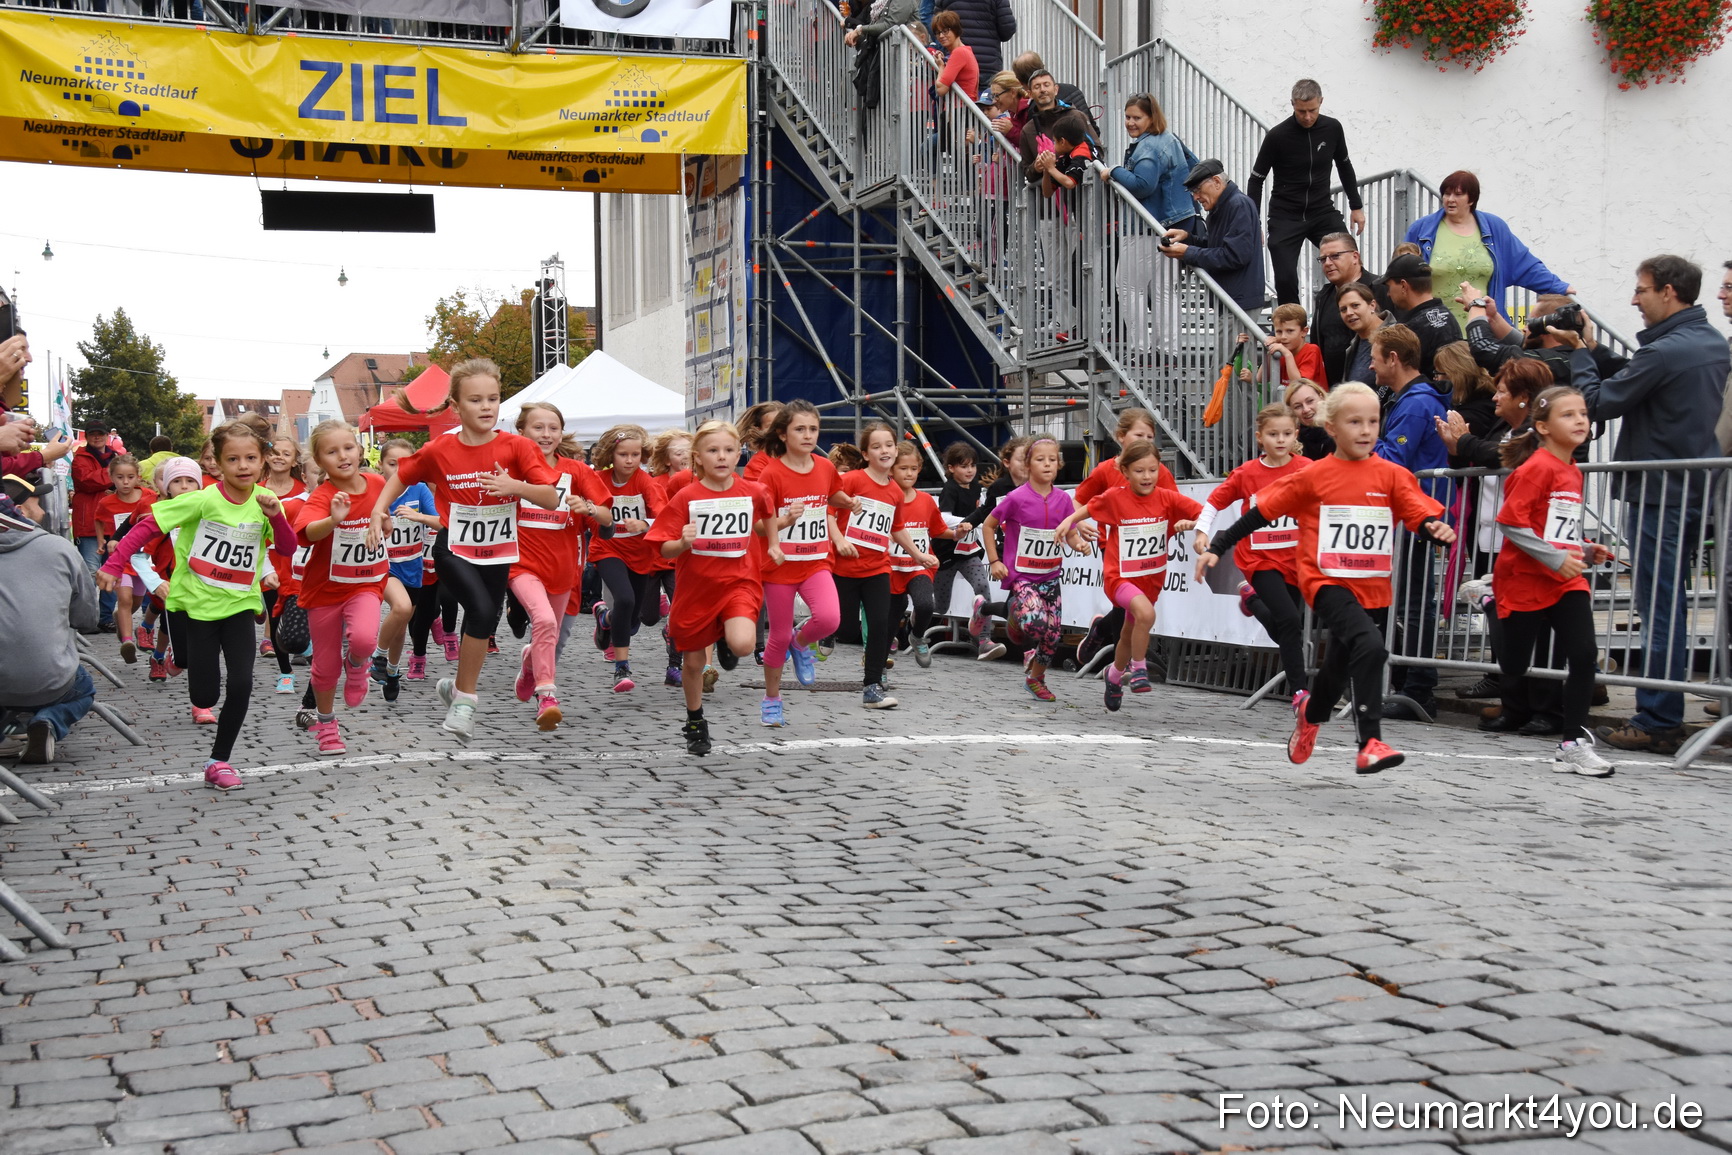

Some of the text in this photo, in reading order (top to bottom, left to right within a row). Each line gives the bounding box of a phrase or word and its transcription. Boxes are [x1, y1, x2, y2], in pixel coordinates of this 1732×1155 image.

[20, 69, 198, 100] Neumarkter Stadtlauf
[298, 59, 467, 126] ZIEL
[559, 108, 710, 123] Neumarkter Stadtlauf
[23, 120, 185, 143] Neumarkter Stadtlauf
[507, 150, 645, 166] Neumarkter Stadtlauf
[449, 481, 482, 489] Stadtlau
[611, 505, 640, 522] 061
[856, 509, 891, 534] 7190
[1120, 517, 1157, 525] Neumarkter
[457, 517, 512, 543] 7074
[697, 512, 749, 535] 7220
[391, 525, 421, 545] 012
[1268, 533, 1292, 541] Emma
[1329, 523, 1389, 550] 7087
[201, 534, 254, 568] 7055
[475, 548, 493, 557] Lisa
[706, 541, 741, 550] Johanna
[1024, 538, 1061, 557] 7078
[1125, 533, 1166, 558] 7224
[1140, 560, 1157, 569] Julia
[1340, 557, 1375, 568] Hannah
[210, 568, 233, 580] Anna
[355, 567, 373, 576] Leni
